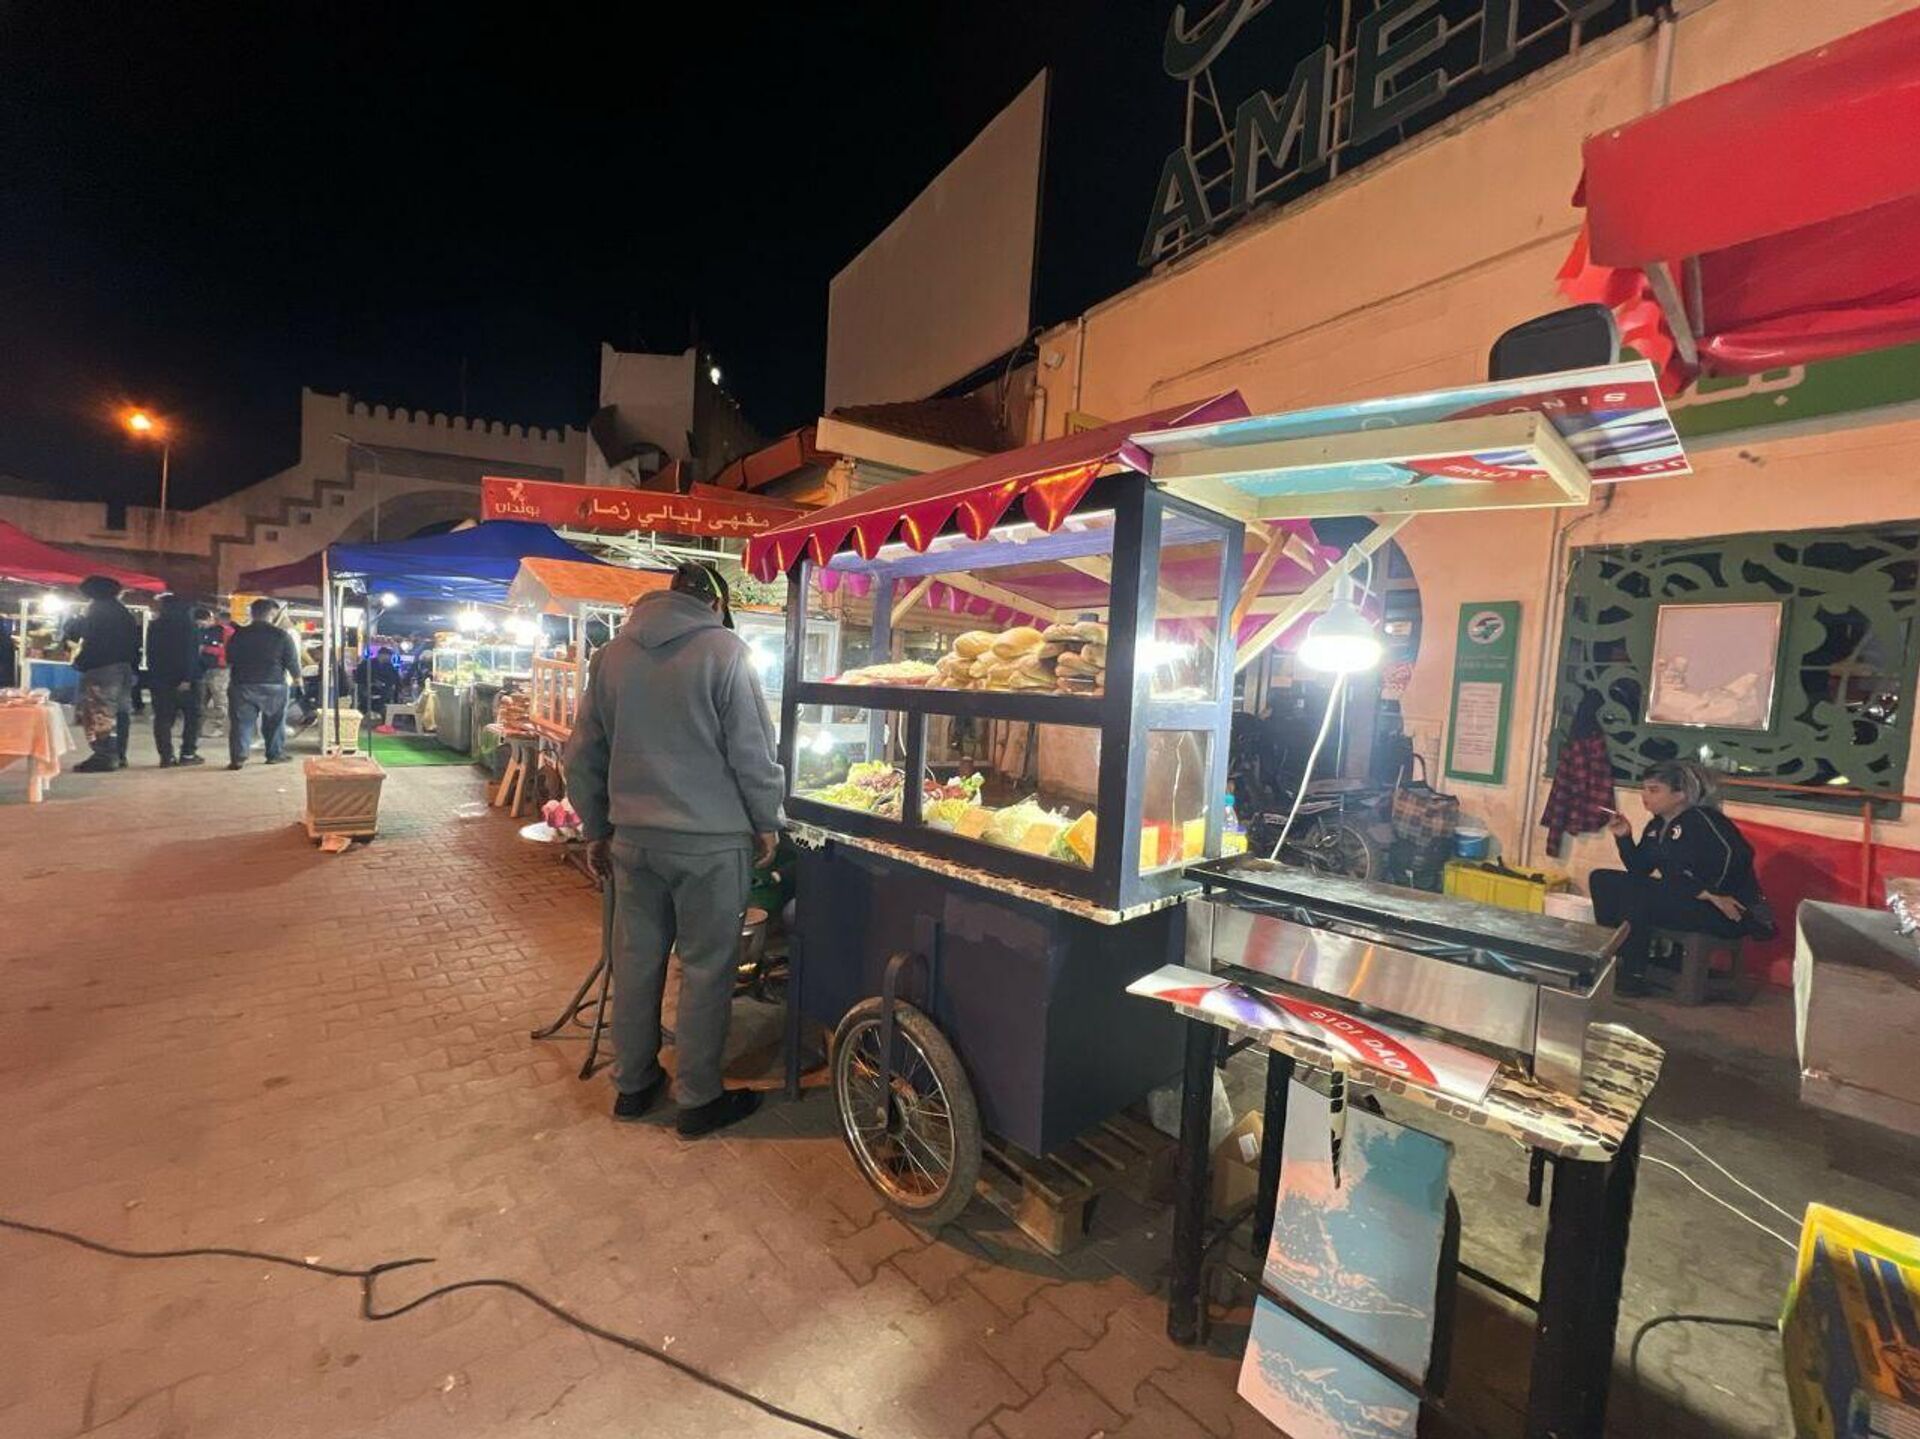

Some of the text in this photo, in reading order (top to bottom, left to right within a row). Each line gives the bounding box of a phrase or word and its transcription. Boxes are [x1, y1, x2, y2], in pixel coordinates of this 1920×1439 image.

[579, 498, 631, 520] زما
[638, 504, 703, 528] ليالي
[1309, 1010, 1364, 1035] SIDI
